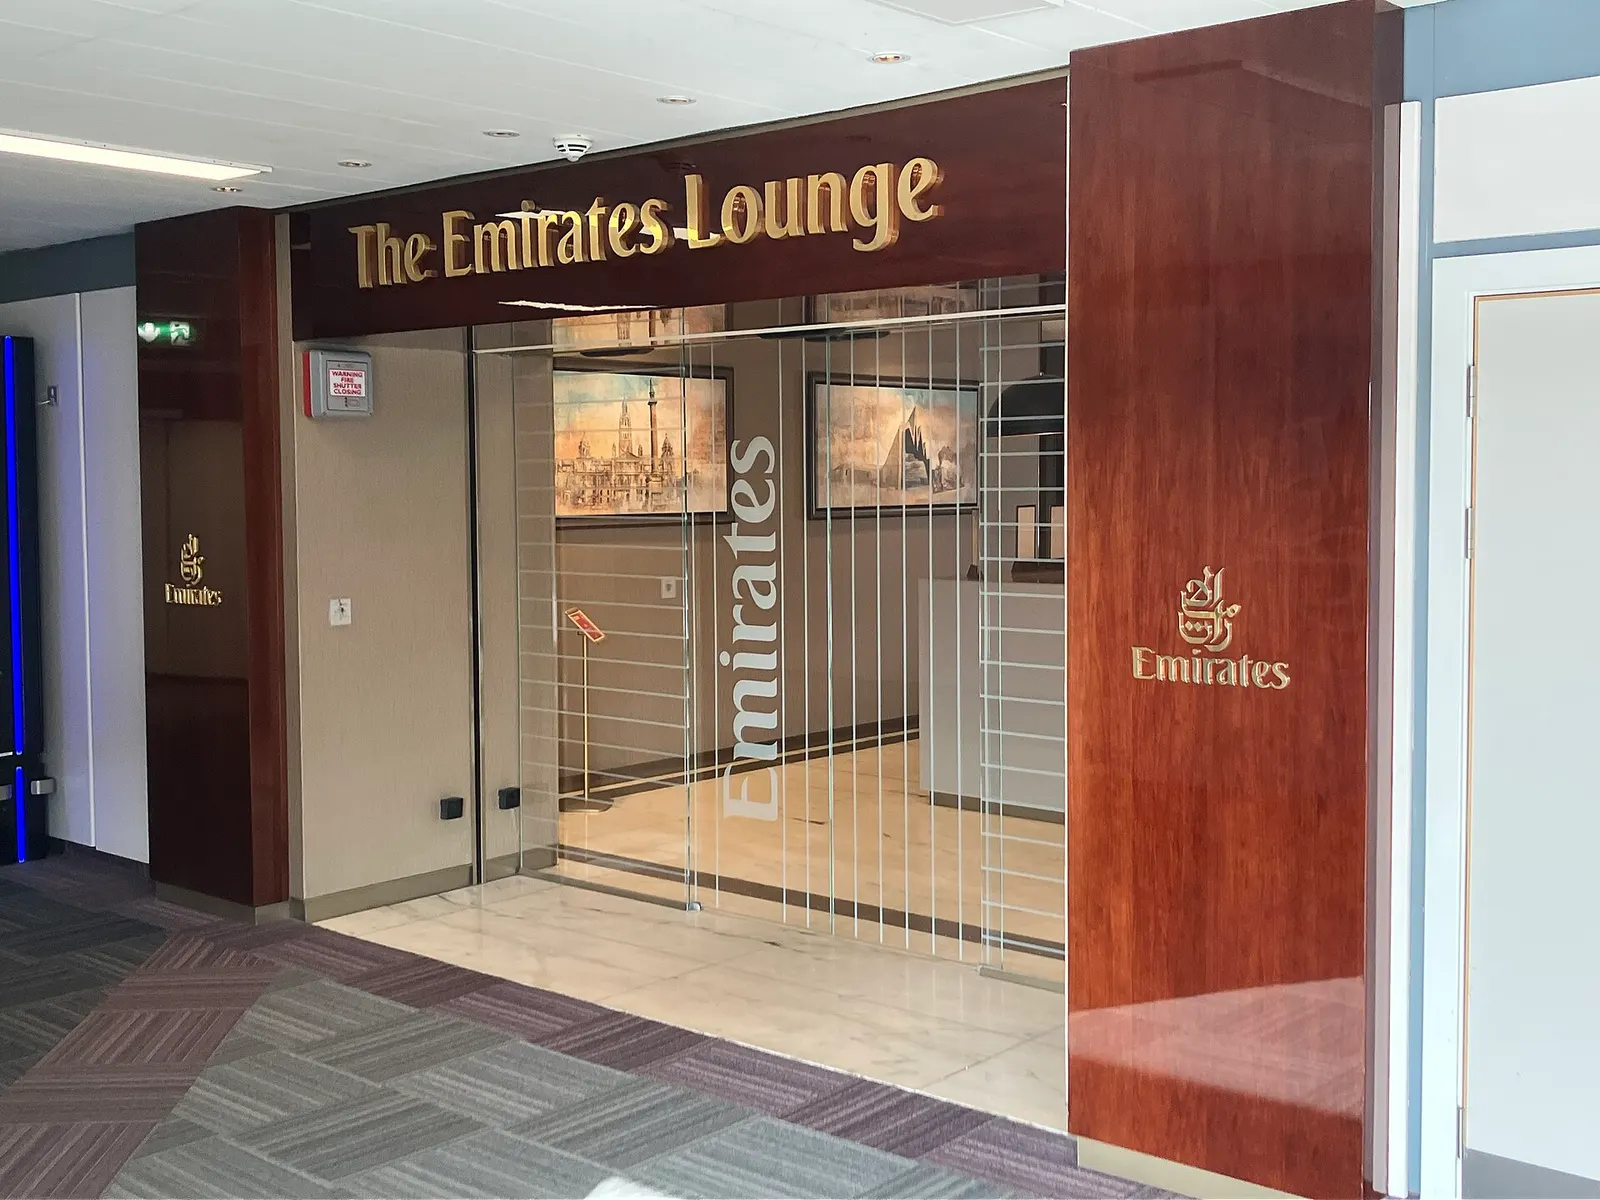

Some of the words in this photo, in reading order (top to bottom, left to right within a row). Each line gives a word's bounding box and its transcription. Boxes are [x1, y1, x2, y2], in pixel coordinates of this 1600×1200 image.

[348, 223, 437, 288] The
[442, 195, 673, 278] Emirates
[684, 157, 944, 252] Lounge
[165, 583, 222, 606] Emirates
[719, 435, 779, 822] Emirates
[1131, 646, 1291, 690] Emirates
